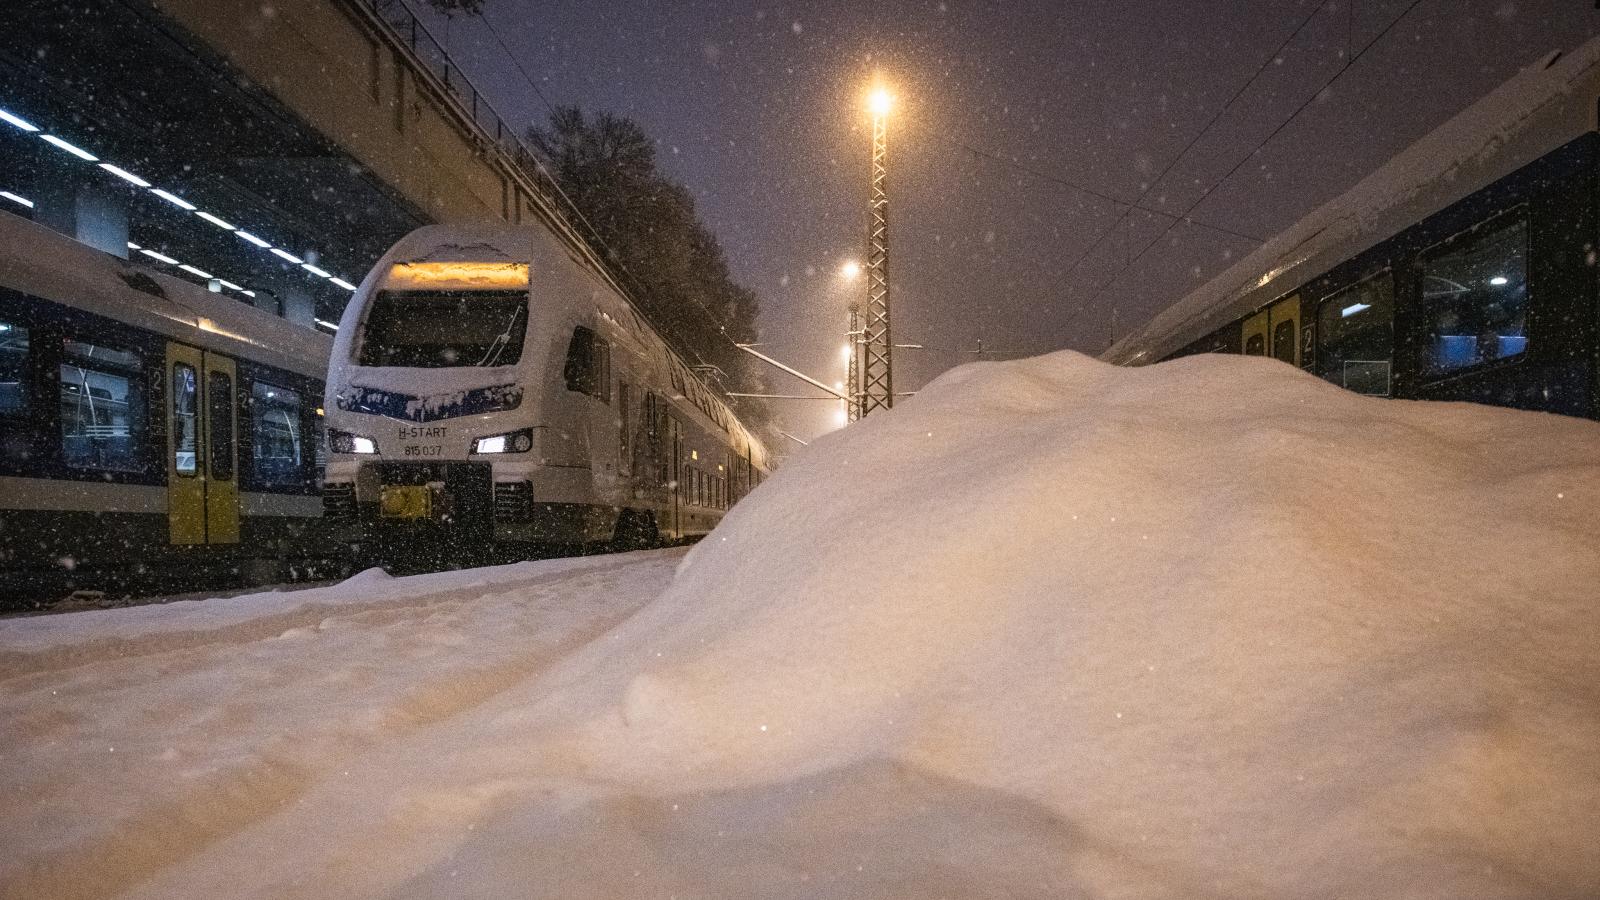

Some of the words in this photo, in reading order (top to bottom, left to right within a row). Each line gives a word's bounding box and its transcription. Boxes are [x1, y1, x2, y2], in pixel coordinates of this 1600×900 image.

[1304, 329, 1312, 352] 2
[153, 371, 161, 390] 2
[241, 391, 249, 408] 2
[398, 427, 448, 439] H-START
[404, 445, 421, 456] 815
[422, 446, 442, 456] 037
